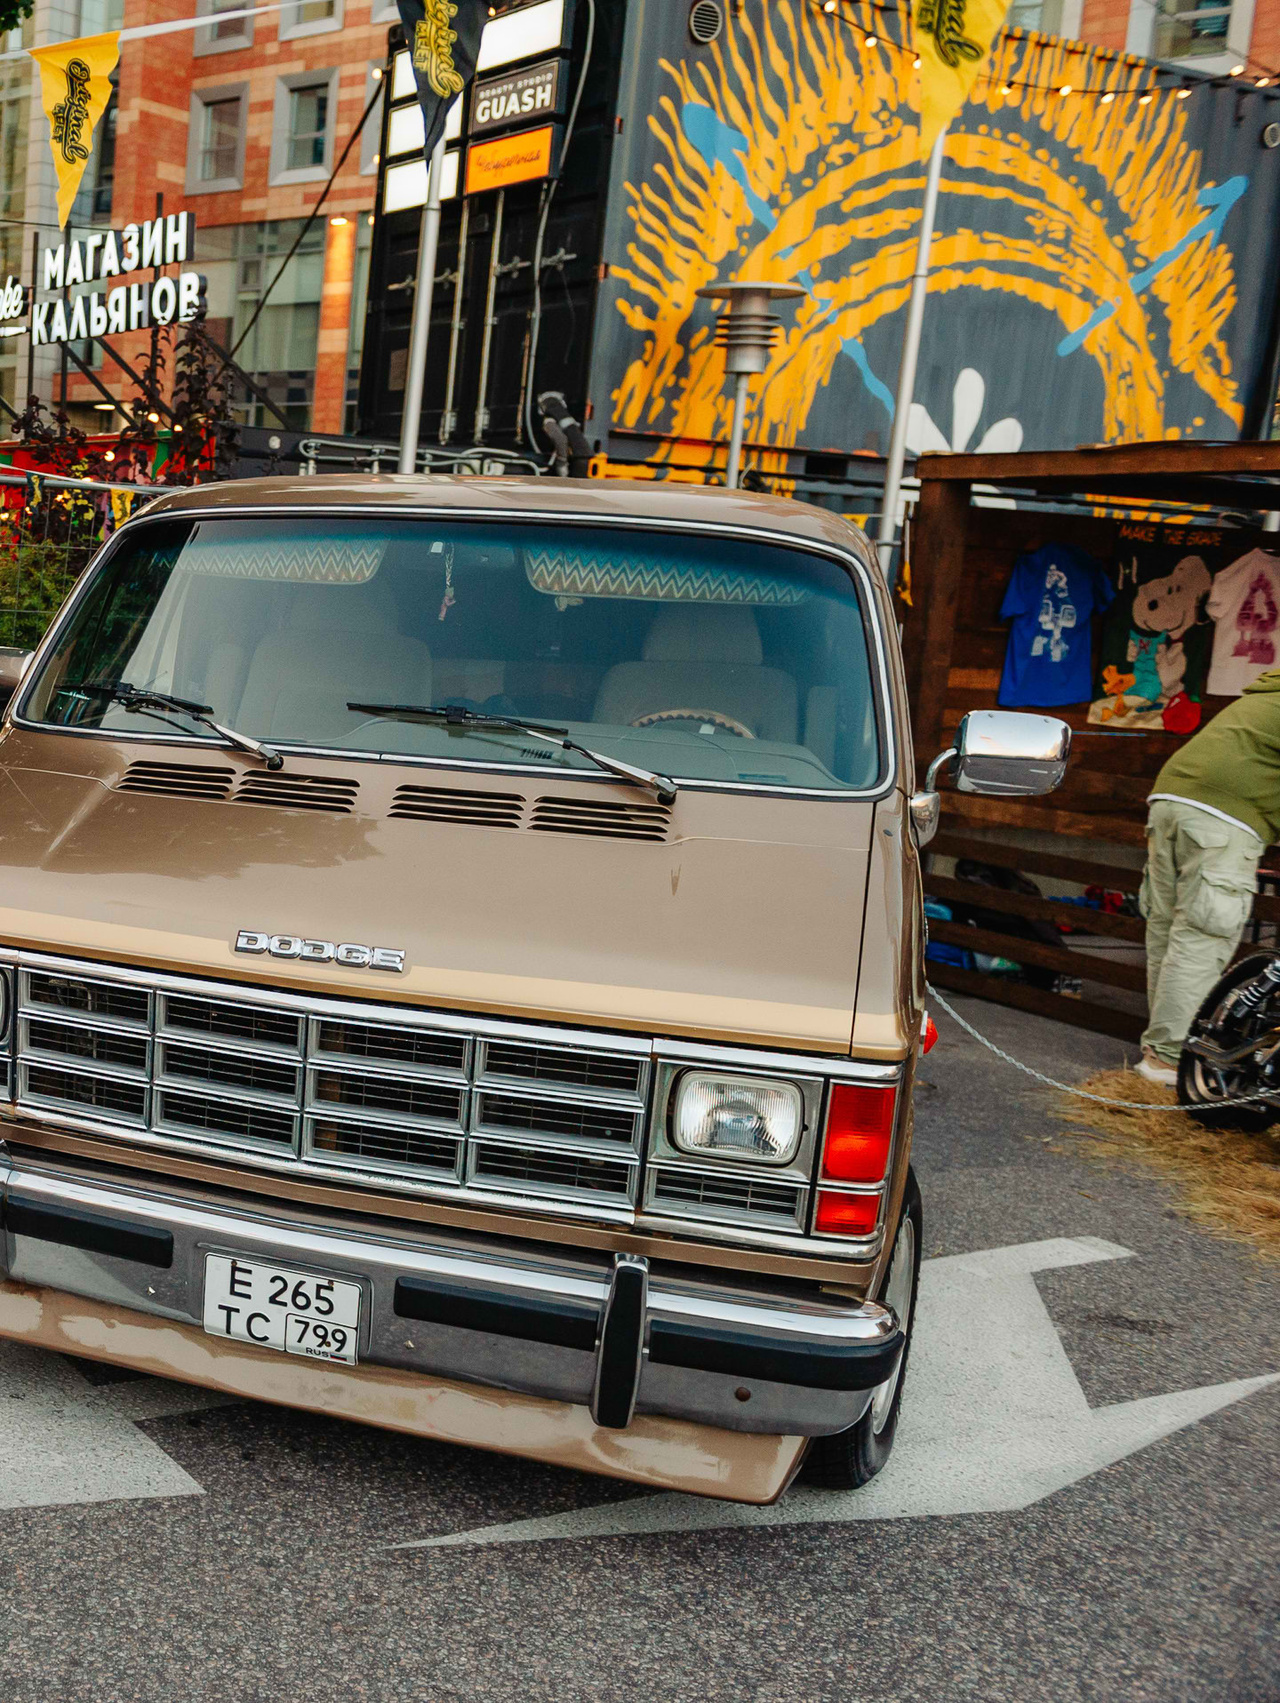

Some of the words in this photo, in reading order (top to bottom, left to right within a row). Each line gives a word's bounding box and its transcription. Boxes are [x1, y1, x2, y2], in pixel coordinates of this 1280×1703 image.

[517, 72, 553, 89] STUDIO
[61, 58, 91, 164] Original
[476, 83, 552, 123] GUASH
[44, 211, 189, 291] МАГАЗИН
[32, 272, 200, 346] КАЛЬЯНОВ
[235, 930, 406, 973] DODGE
[230, 1265, 252, 1299] E
[269, 1275, 334, 1315] 265
[295, 1319, 347, 1352] 799
[306, 1347, 329, 1358] RUS
